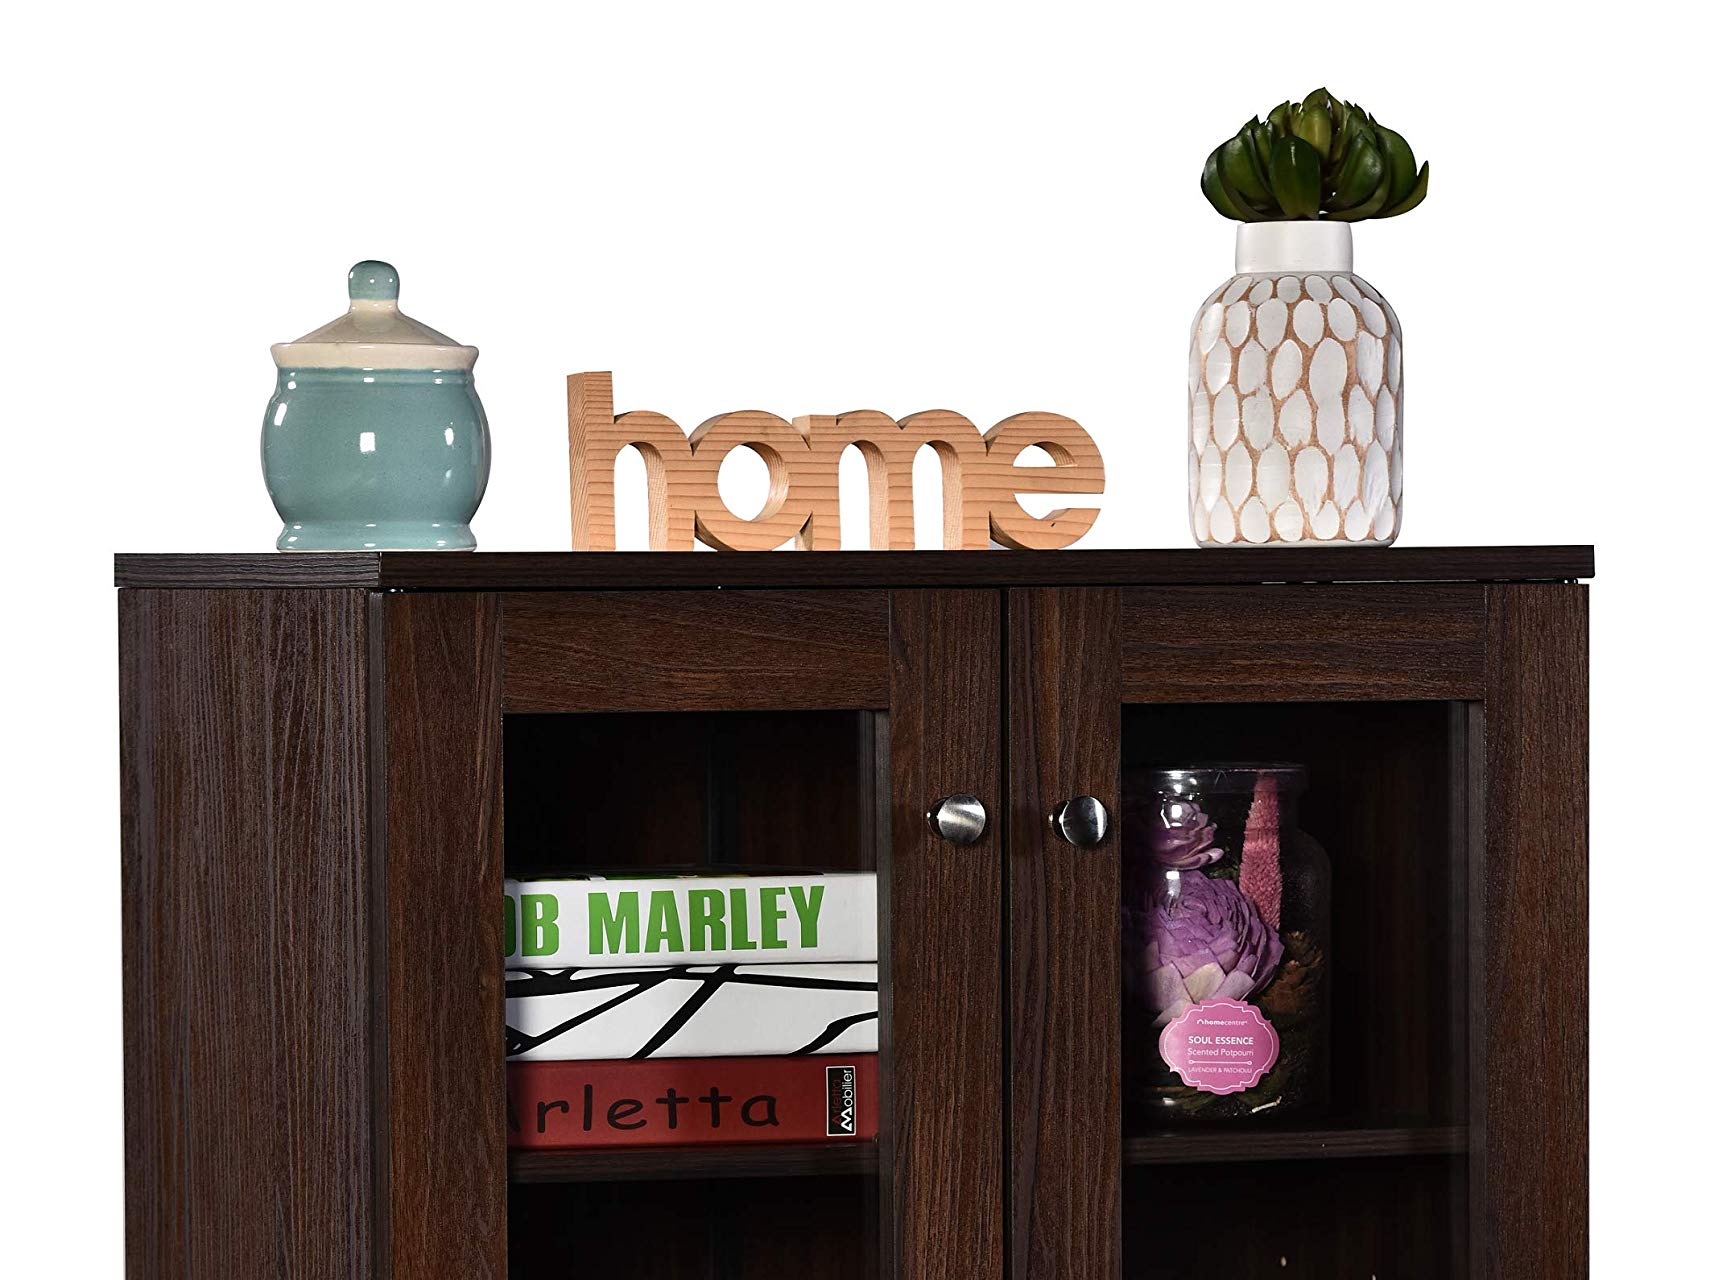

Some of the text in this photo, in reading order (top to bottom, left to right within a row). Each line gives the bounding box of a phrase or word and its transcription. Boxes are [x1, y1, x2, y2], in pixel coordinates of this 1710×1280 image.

[567, 371, 1106, 552] home
[588, 885, 825, 955] MARLEY
[1187, 1047, 1219, 1056] Scented
[1188, 1036, 1254, 1046] SOUL ESSENCE
[841, 1069, 853, 1132] Mobilier
